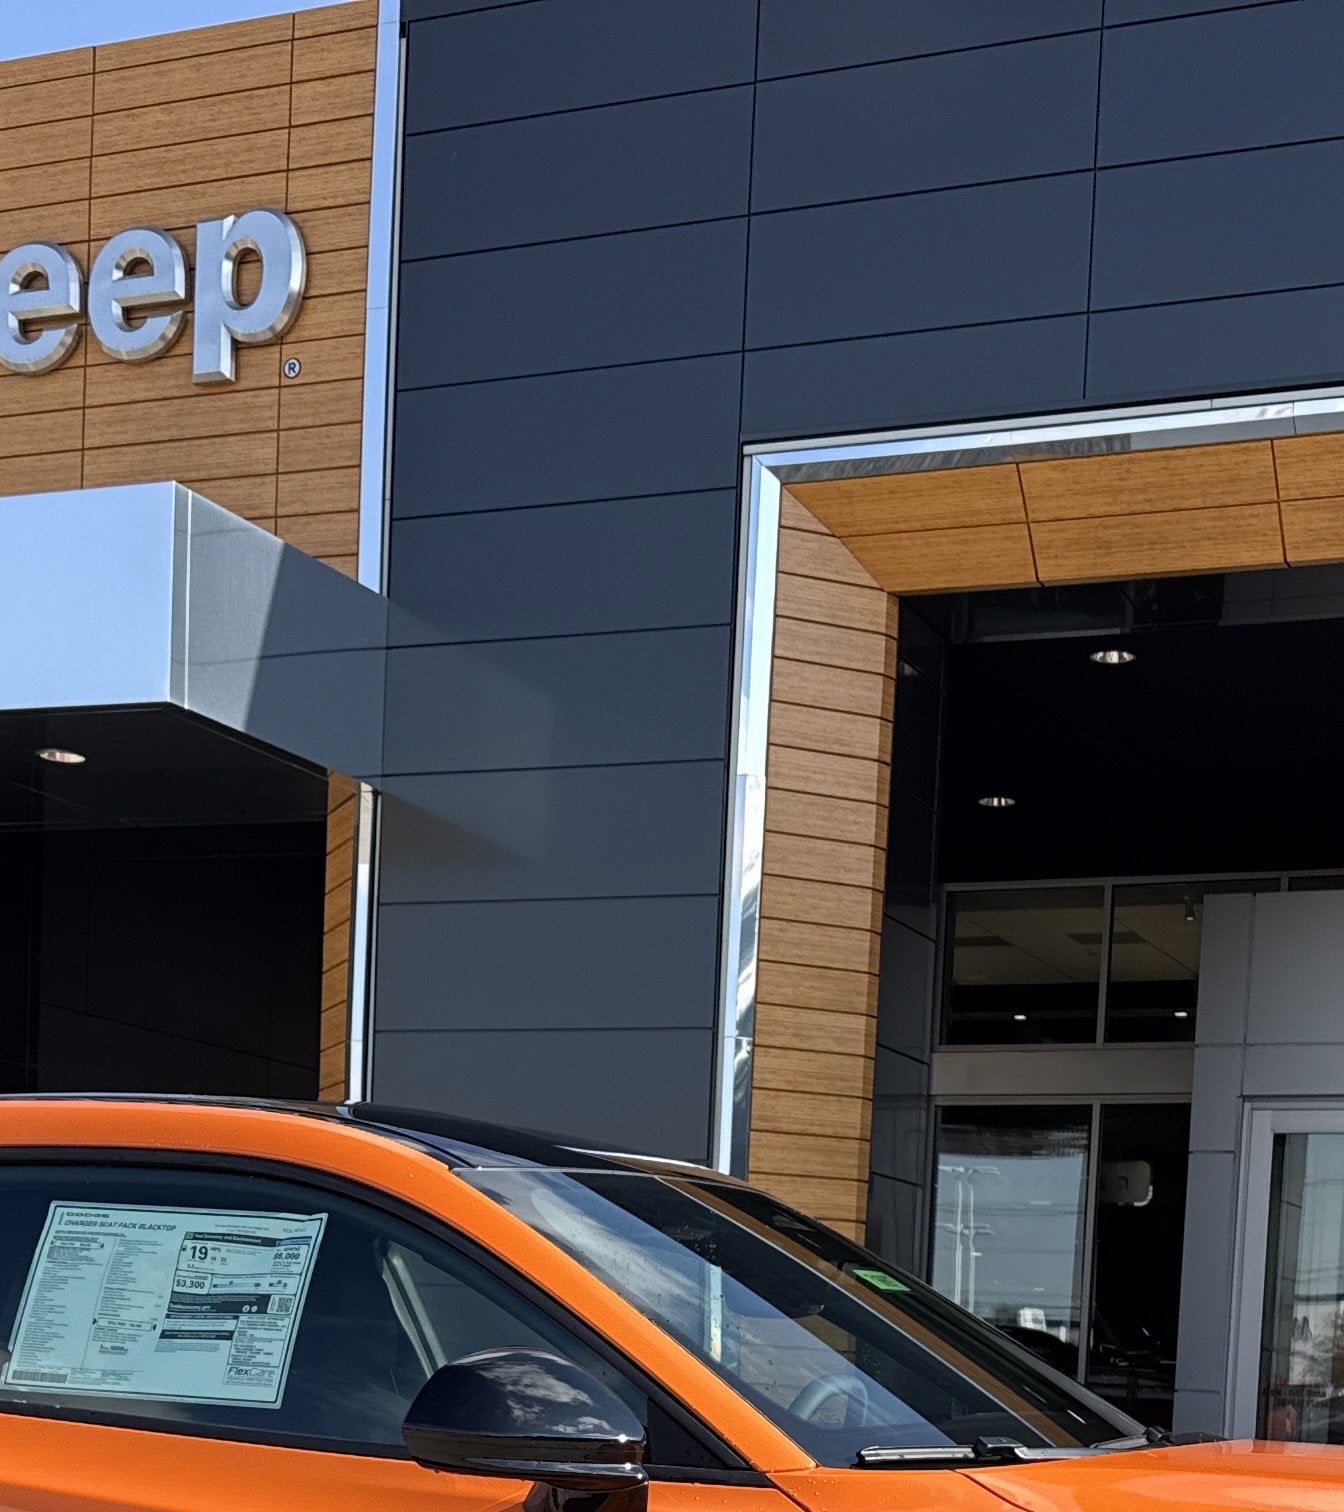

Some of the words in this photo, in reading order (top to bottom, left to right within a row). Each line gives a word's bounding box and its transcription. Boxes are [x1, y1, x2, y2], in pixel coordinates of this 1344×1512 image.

[64, 1219, 98, 1228] CHARGER
[118, 1222, 138, 1230] PACK
[138, 1223, 177, 1232] BLACKTOP
[191, 1245, 208, 1260] 19
[175, 1278, 205, 1290] $3,300
[227, 1366, 276, 1378] FlexCare
